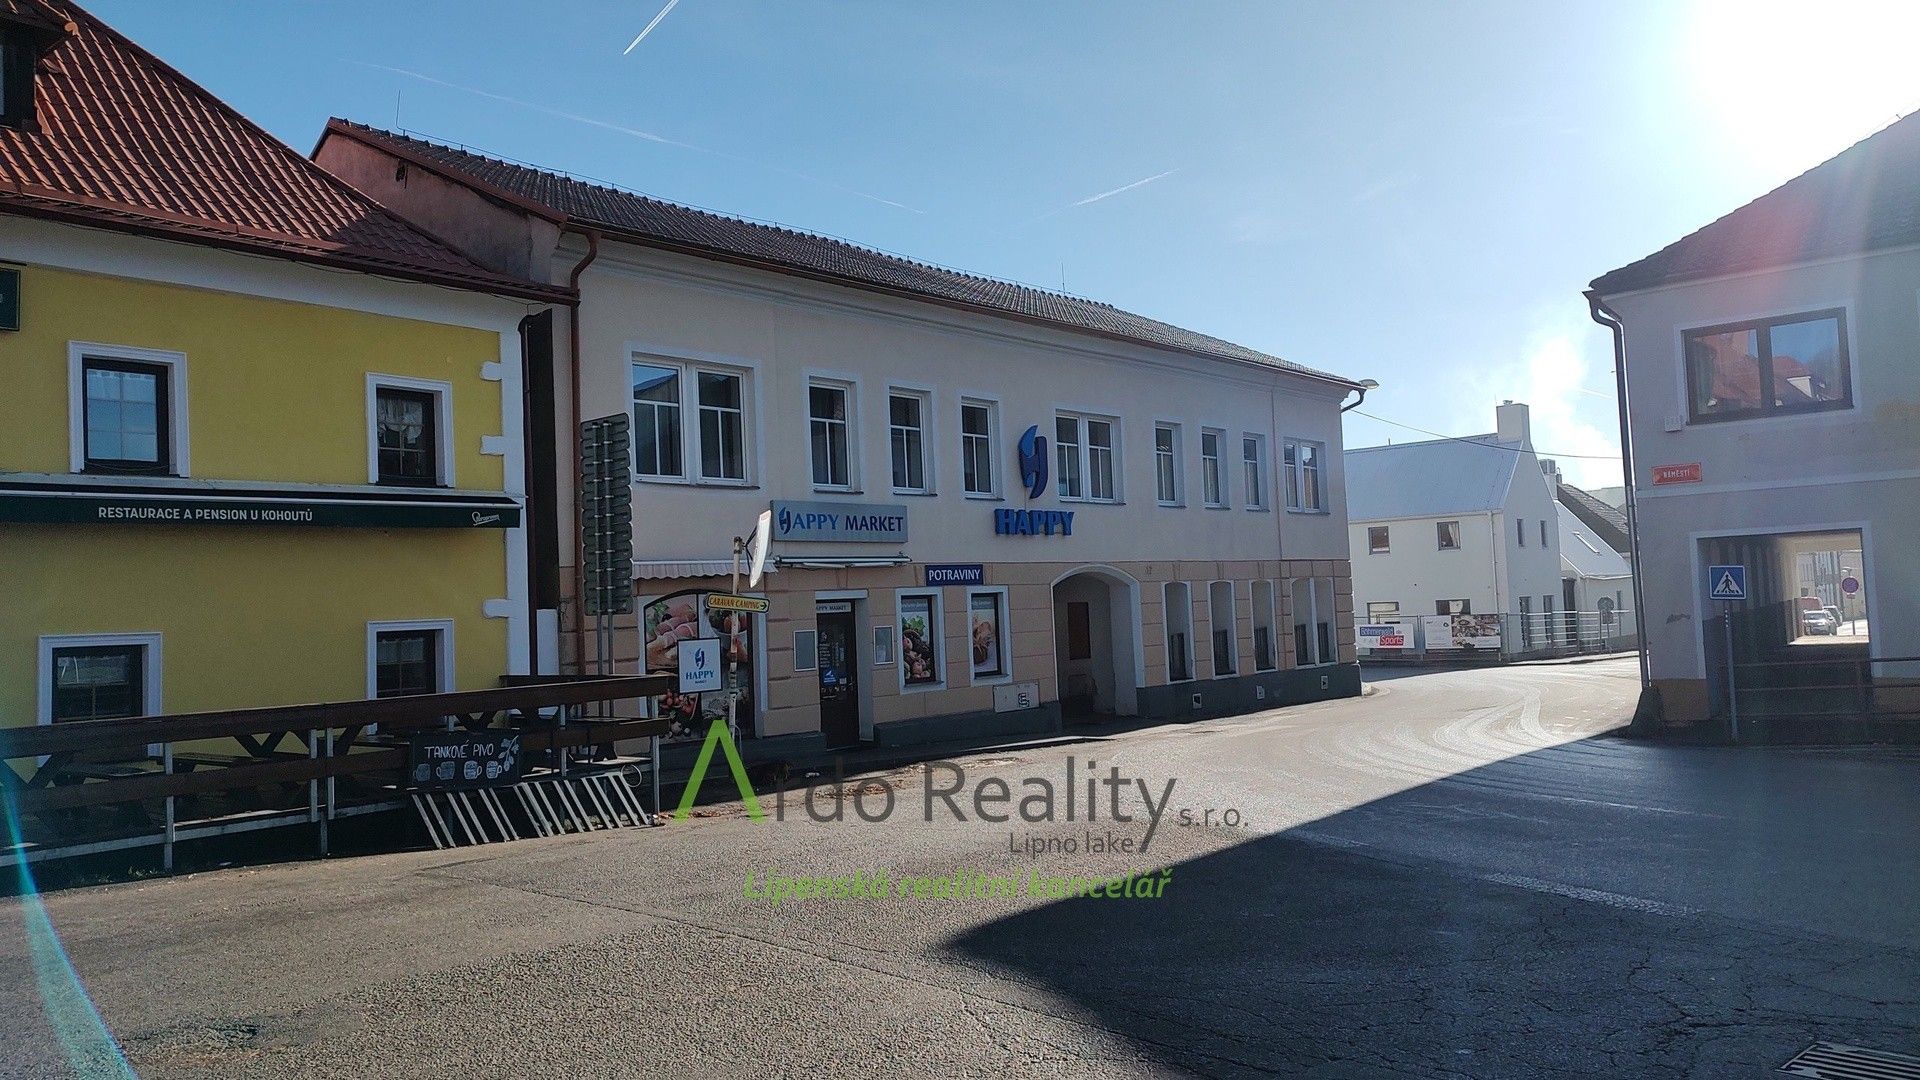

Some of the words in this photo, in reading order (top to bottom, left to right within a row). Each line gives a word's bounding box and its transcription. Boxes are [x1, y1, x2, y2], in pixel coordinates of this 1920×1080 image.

[98, 506, 180, 520] RESTAURACE
[183, 508, 193, 520] A
[195, 508, 247, 521] PENSION
[249, 509, 259, 521] U
[261, 507, 313, 522] KOHOUTŮ
[778, 506, 839, 535] HAPPY
[845, 515, 904, 532] MARKET
[994, 508, 1075, 536] HAPPY
[928, 569, 980, 581] POTRAVINY
[710, 595, 735, 606] CARAVAN
[736, 598, 759, 609] CAMPING
[1380, 635, 1404, 645] Sports
[686, 670, 714, 680] HAPPY
[424, 739, 470, 759] TANKOVÉ
[472, 743, 494, 756] PIVO
